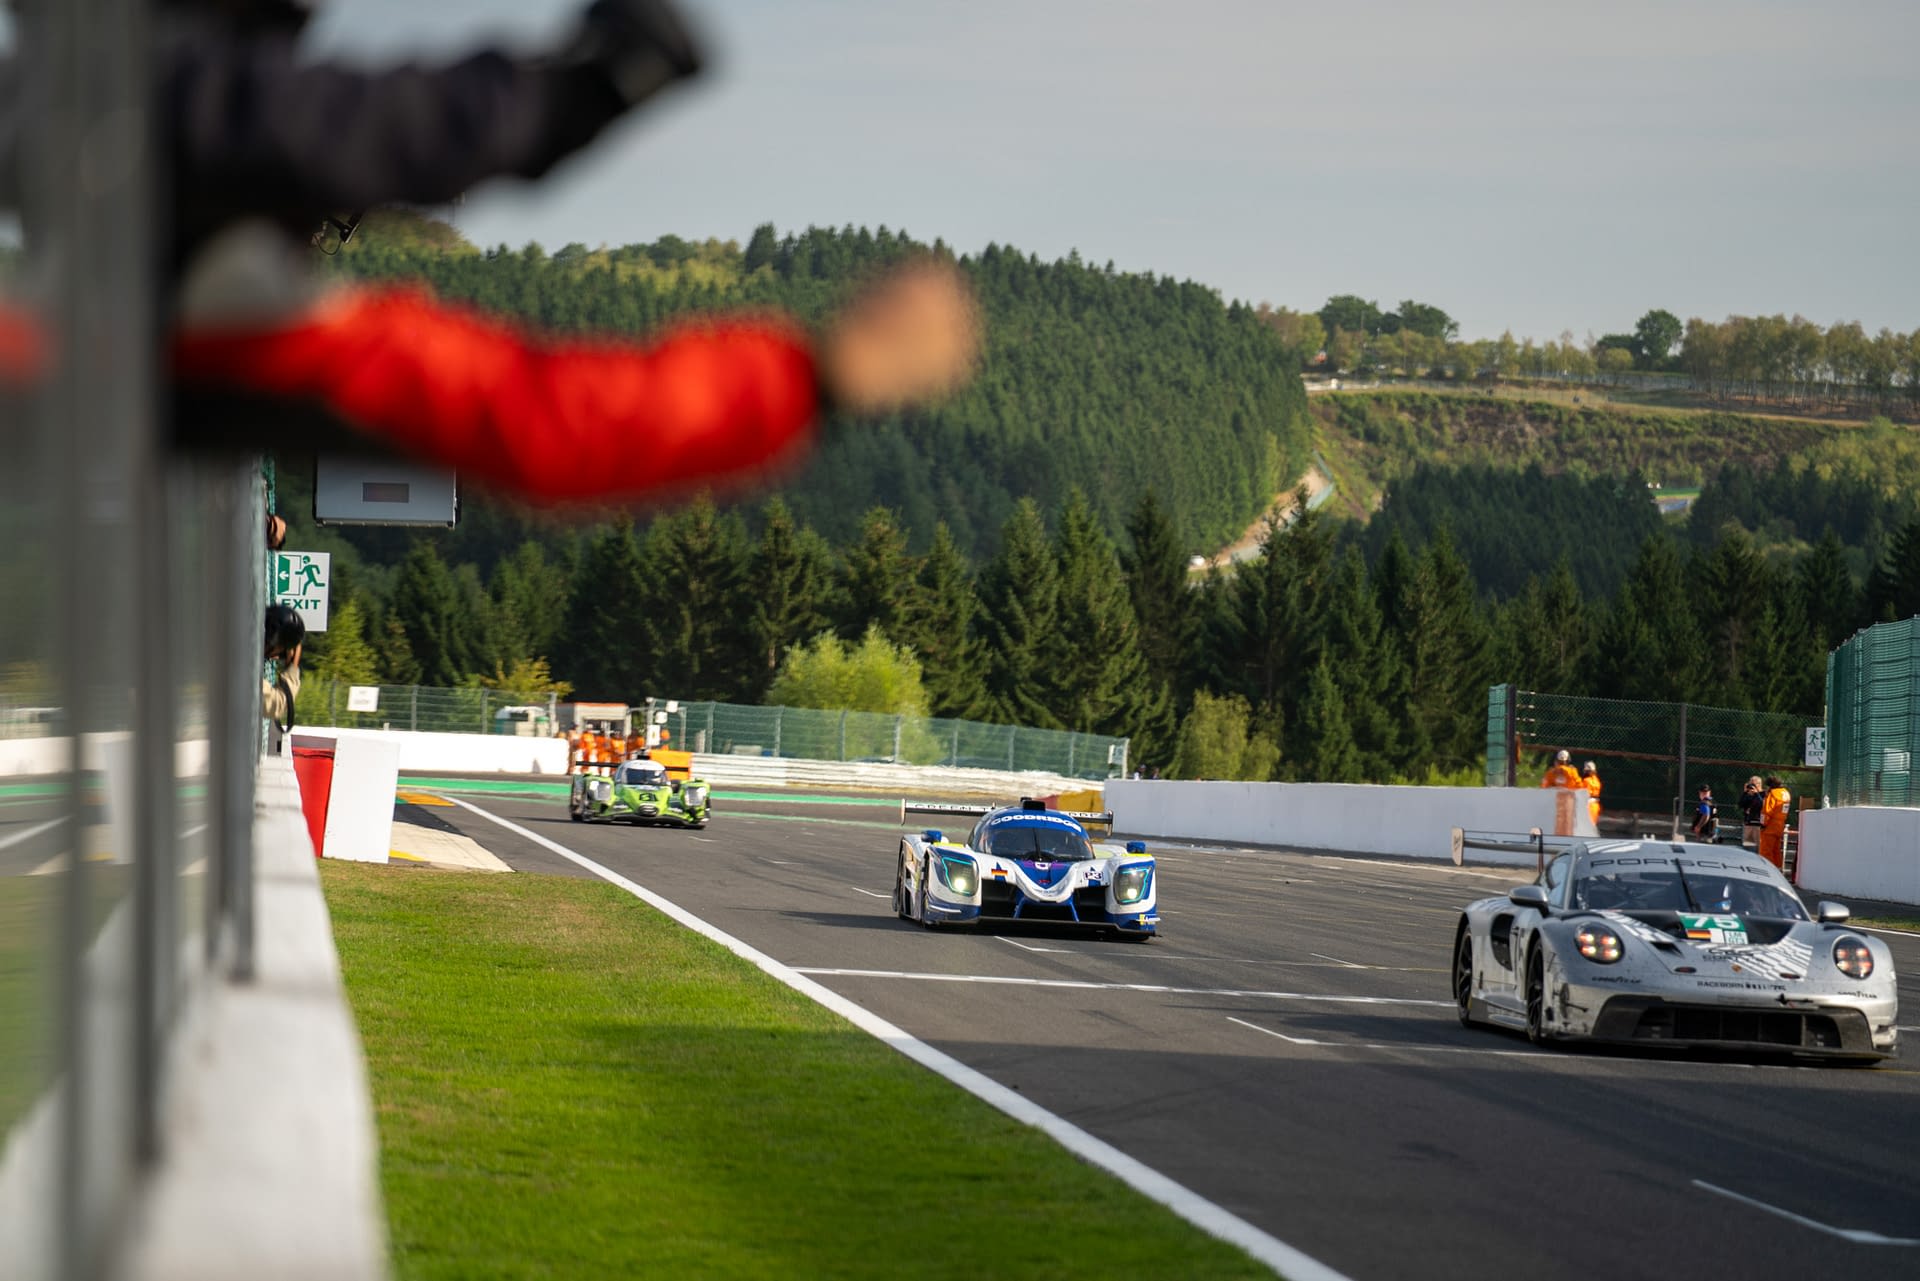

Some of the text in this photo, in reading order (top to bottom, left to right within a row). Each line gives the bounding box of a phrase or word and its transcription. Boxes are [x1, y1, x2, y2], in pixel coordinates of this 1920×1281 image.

[281, 598, 321, 610] EXIT
[990, 814, 1082, 833] GOODRIDGE
[1590, 857, 1769, 878] PORSCHE
[1684, 914, 1740, 929] 75
